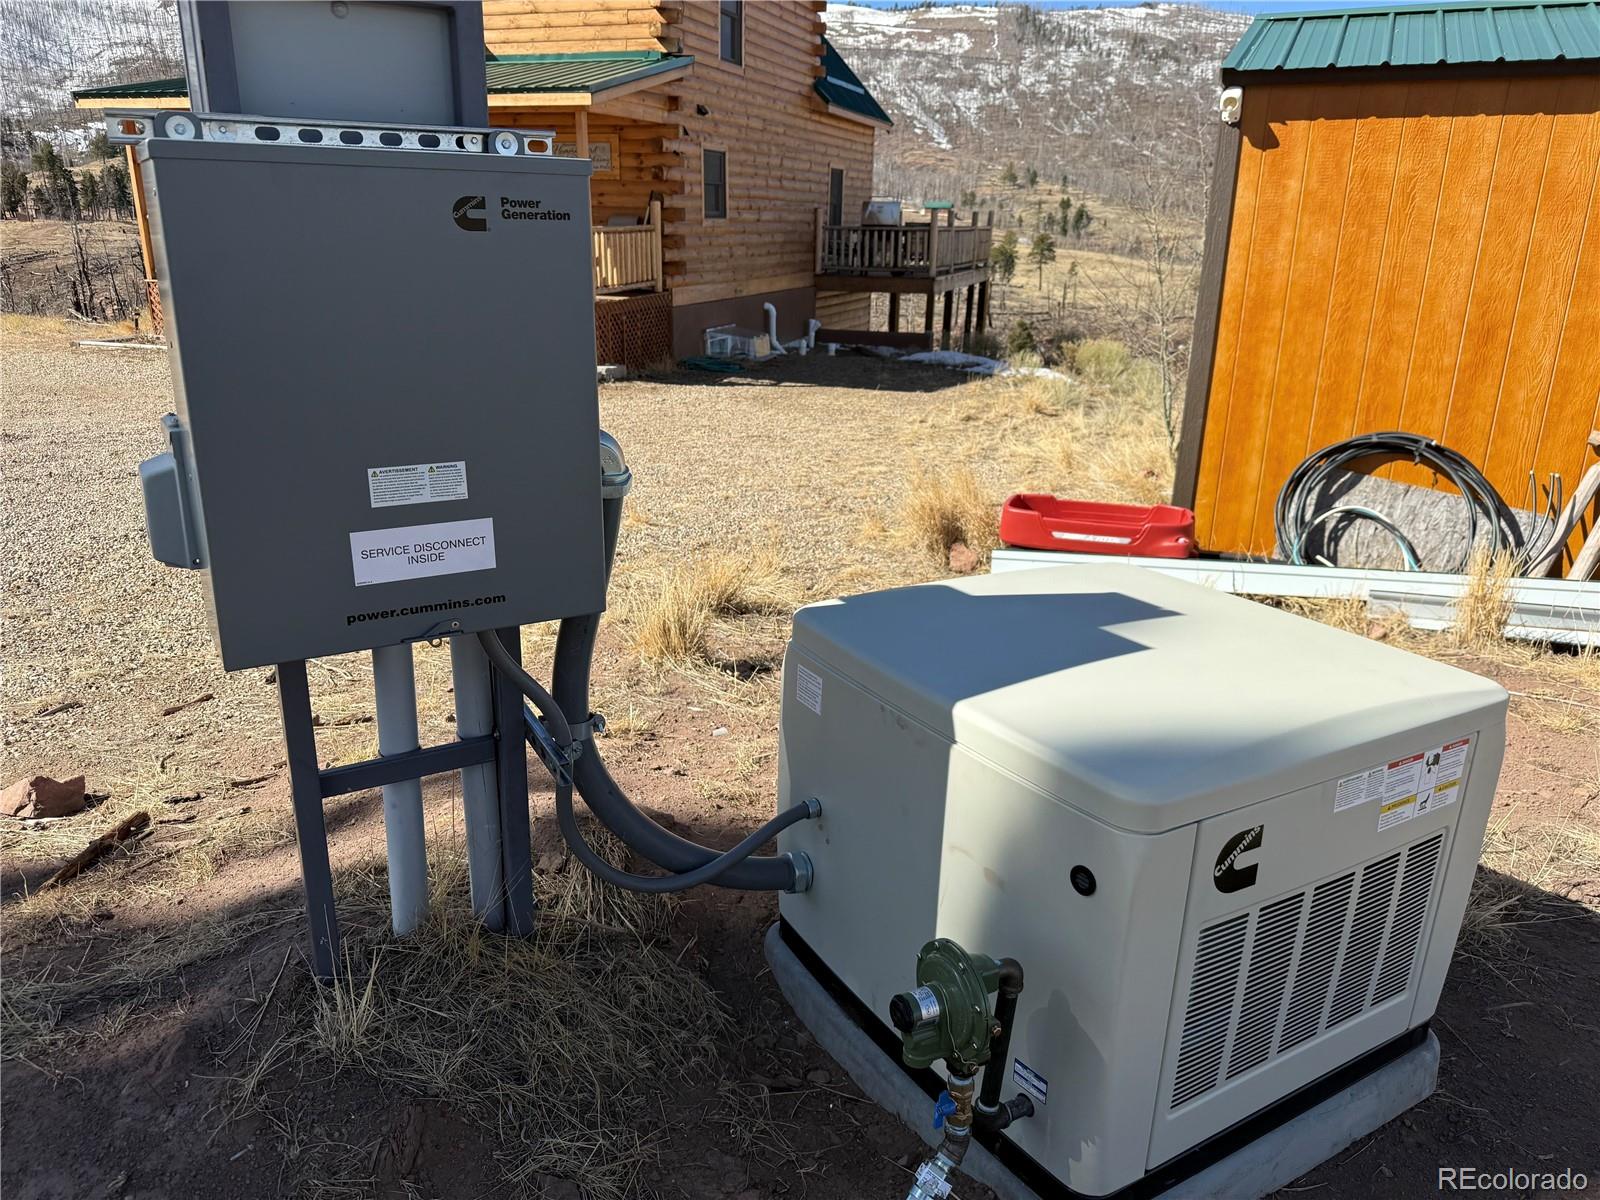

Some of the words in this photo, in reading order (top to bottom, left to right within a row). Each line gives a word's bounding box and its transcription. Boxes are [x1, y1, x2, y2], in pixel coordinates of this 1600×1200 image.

[500, 196, 541, 209] Power
[501, 208, 571, 221] Generation
[378, 466, 419, 475] AVERTISSEMENT
[360, 544, 410, 560] SERVICE
[413, 536, 487, 553] DISCONNECT
[407, 552, 446, 565] INSIDE
[346, 594, 506, 626] power.cummins.com
[1214, 825, 1262, 877] Cummins
